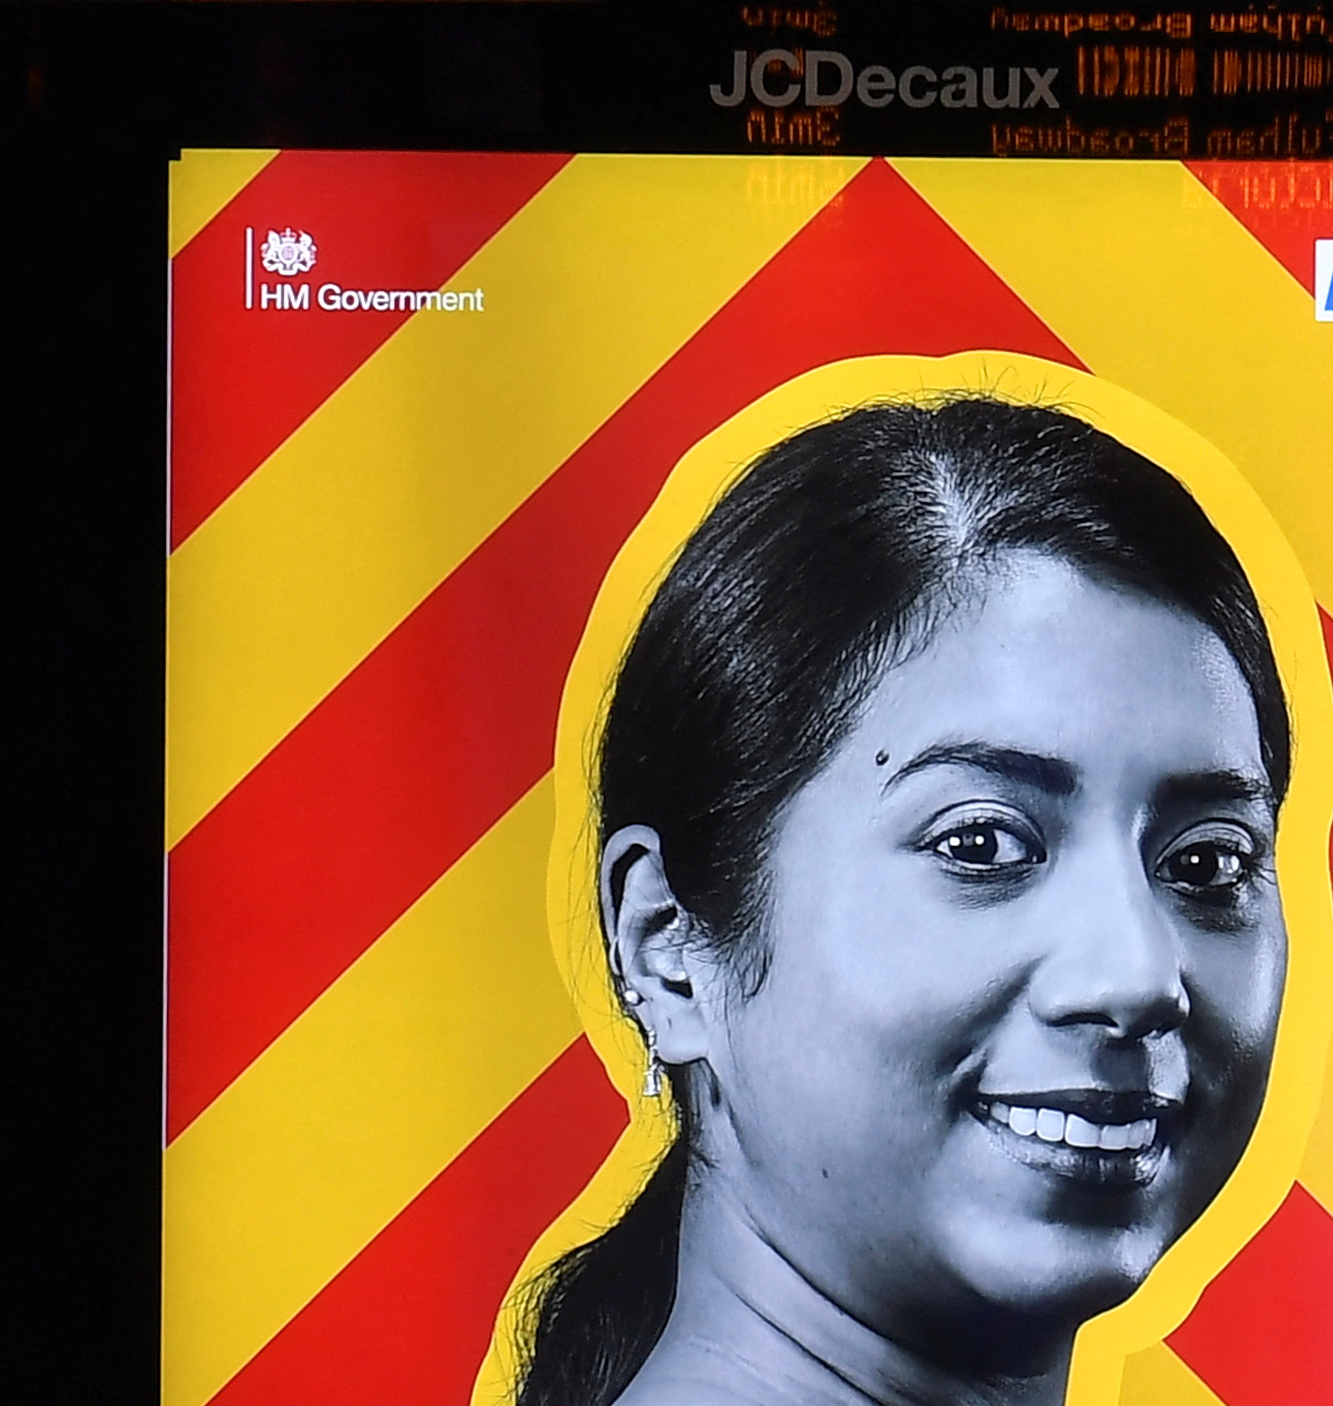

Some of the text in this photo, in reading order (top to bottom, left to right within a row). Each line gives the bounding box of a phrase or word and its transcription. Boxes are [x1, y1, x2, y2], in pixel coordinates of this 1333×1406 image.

[709, 48, 1061, 109] JCDecaux
[260, 283, 485, 312] HM Government
